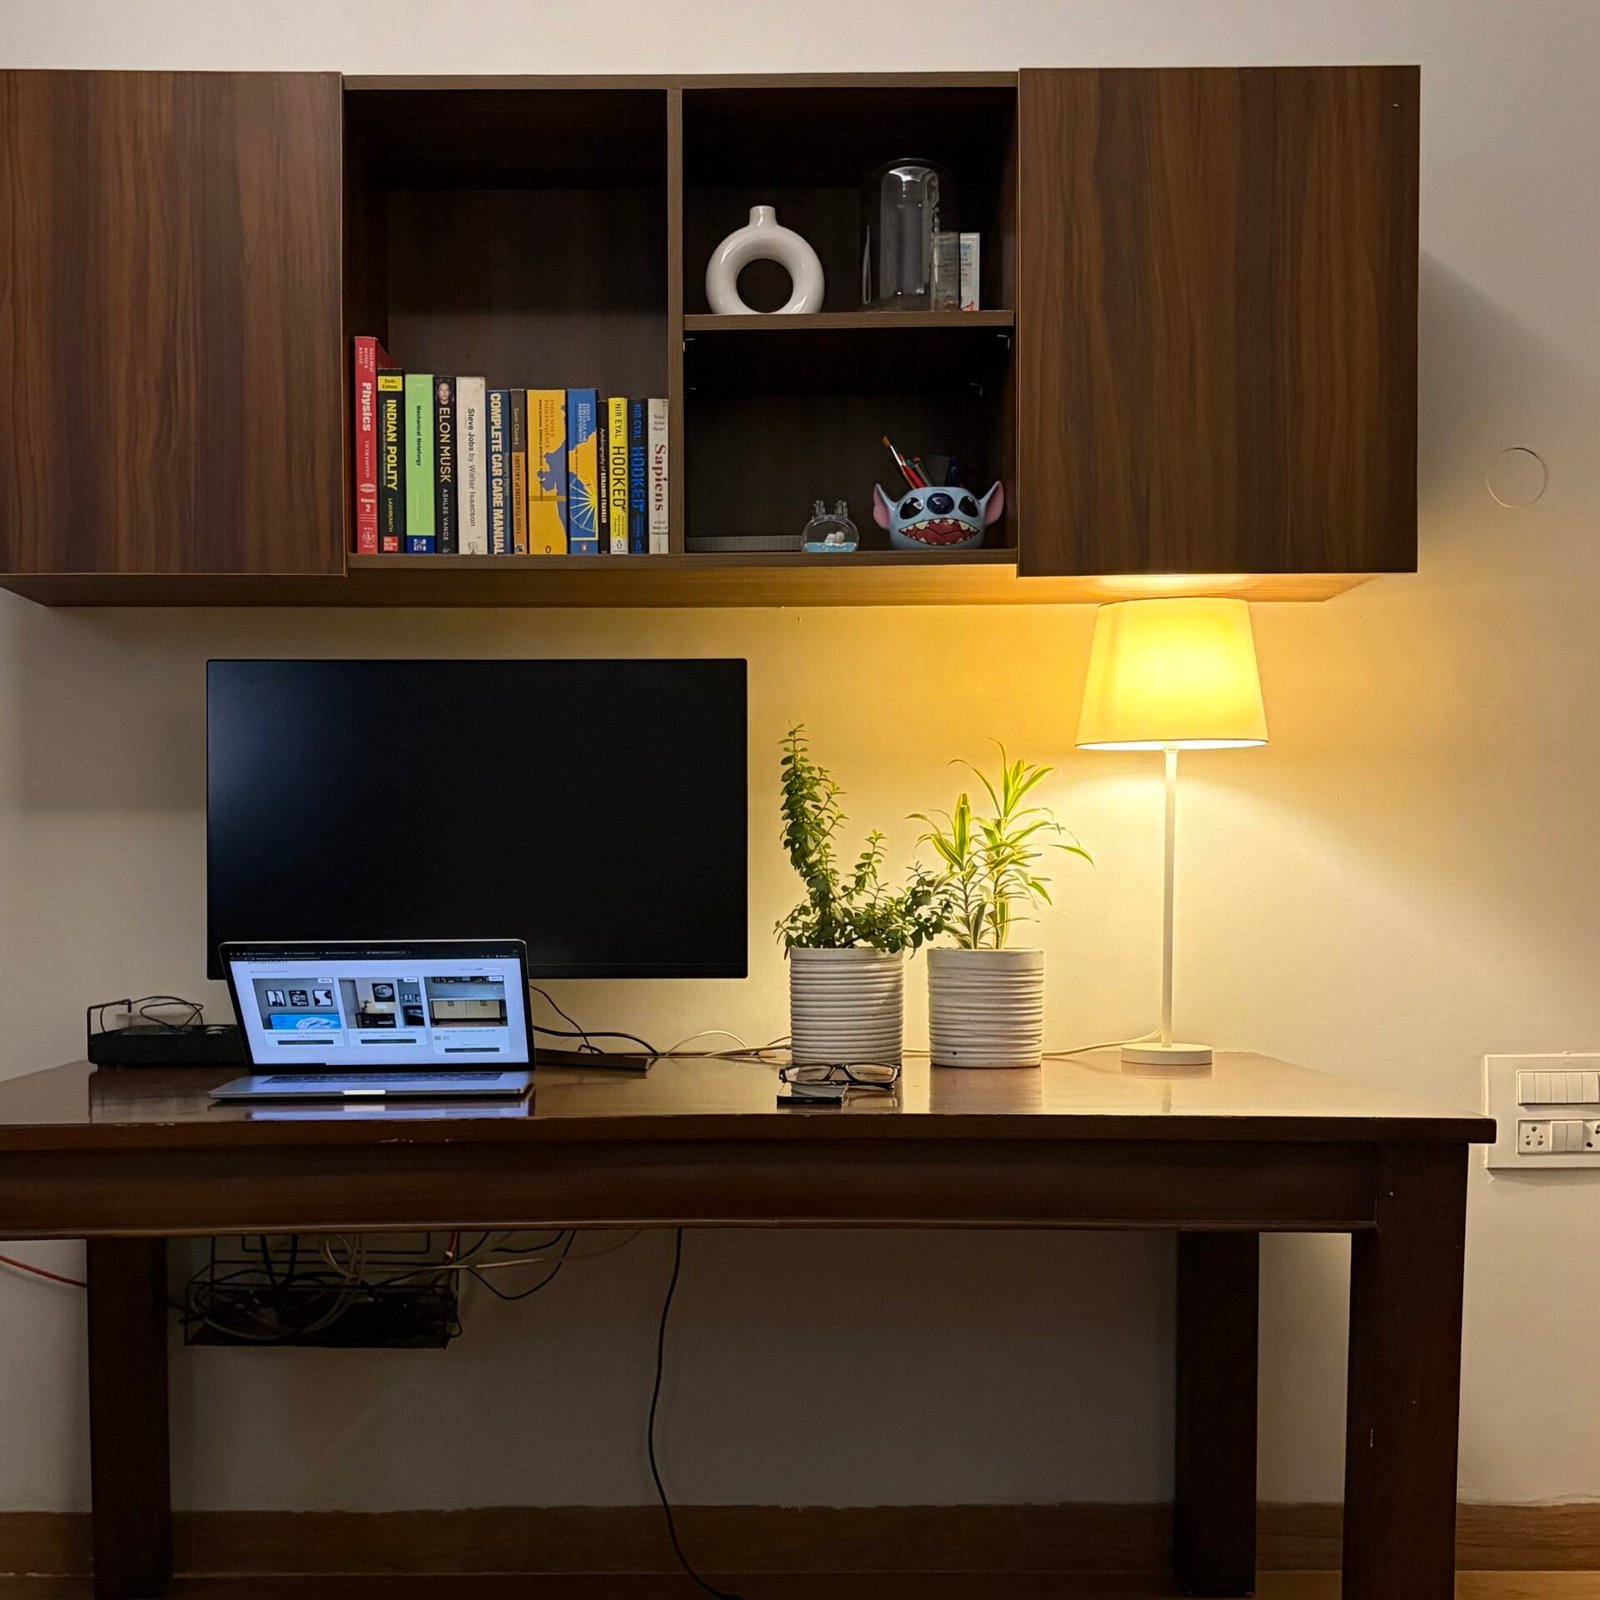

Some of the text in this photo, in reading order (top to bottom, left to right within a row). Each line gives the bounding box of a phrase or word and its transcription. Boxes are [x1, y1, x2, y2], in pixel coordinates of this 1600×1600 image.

[362, 383, 373, 432] Physics
[387, 400, 398, 490] INDIAN POLITY
[440, 408, 451, 483] ELON MUSK
[468, 454, 475, 463] by
[490, 393, 504, 554] COMPLETE CAR CARE MANUAL
[612, 446, 626, 508] HOOKED
[631, 446, 646, 509] HOOKED
[652, 444, 668, 512] Sapiens
